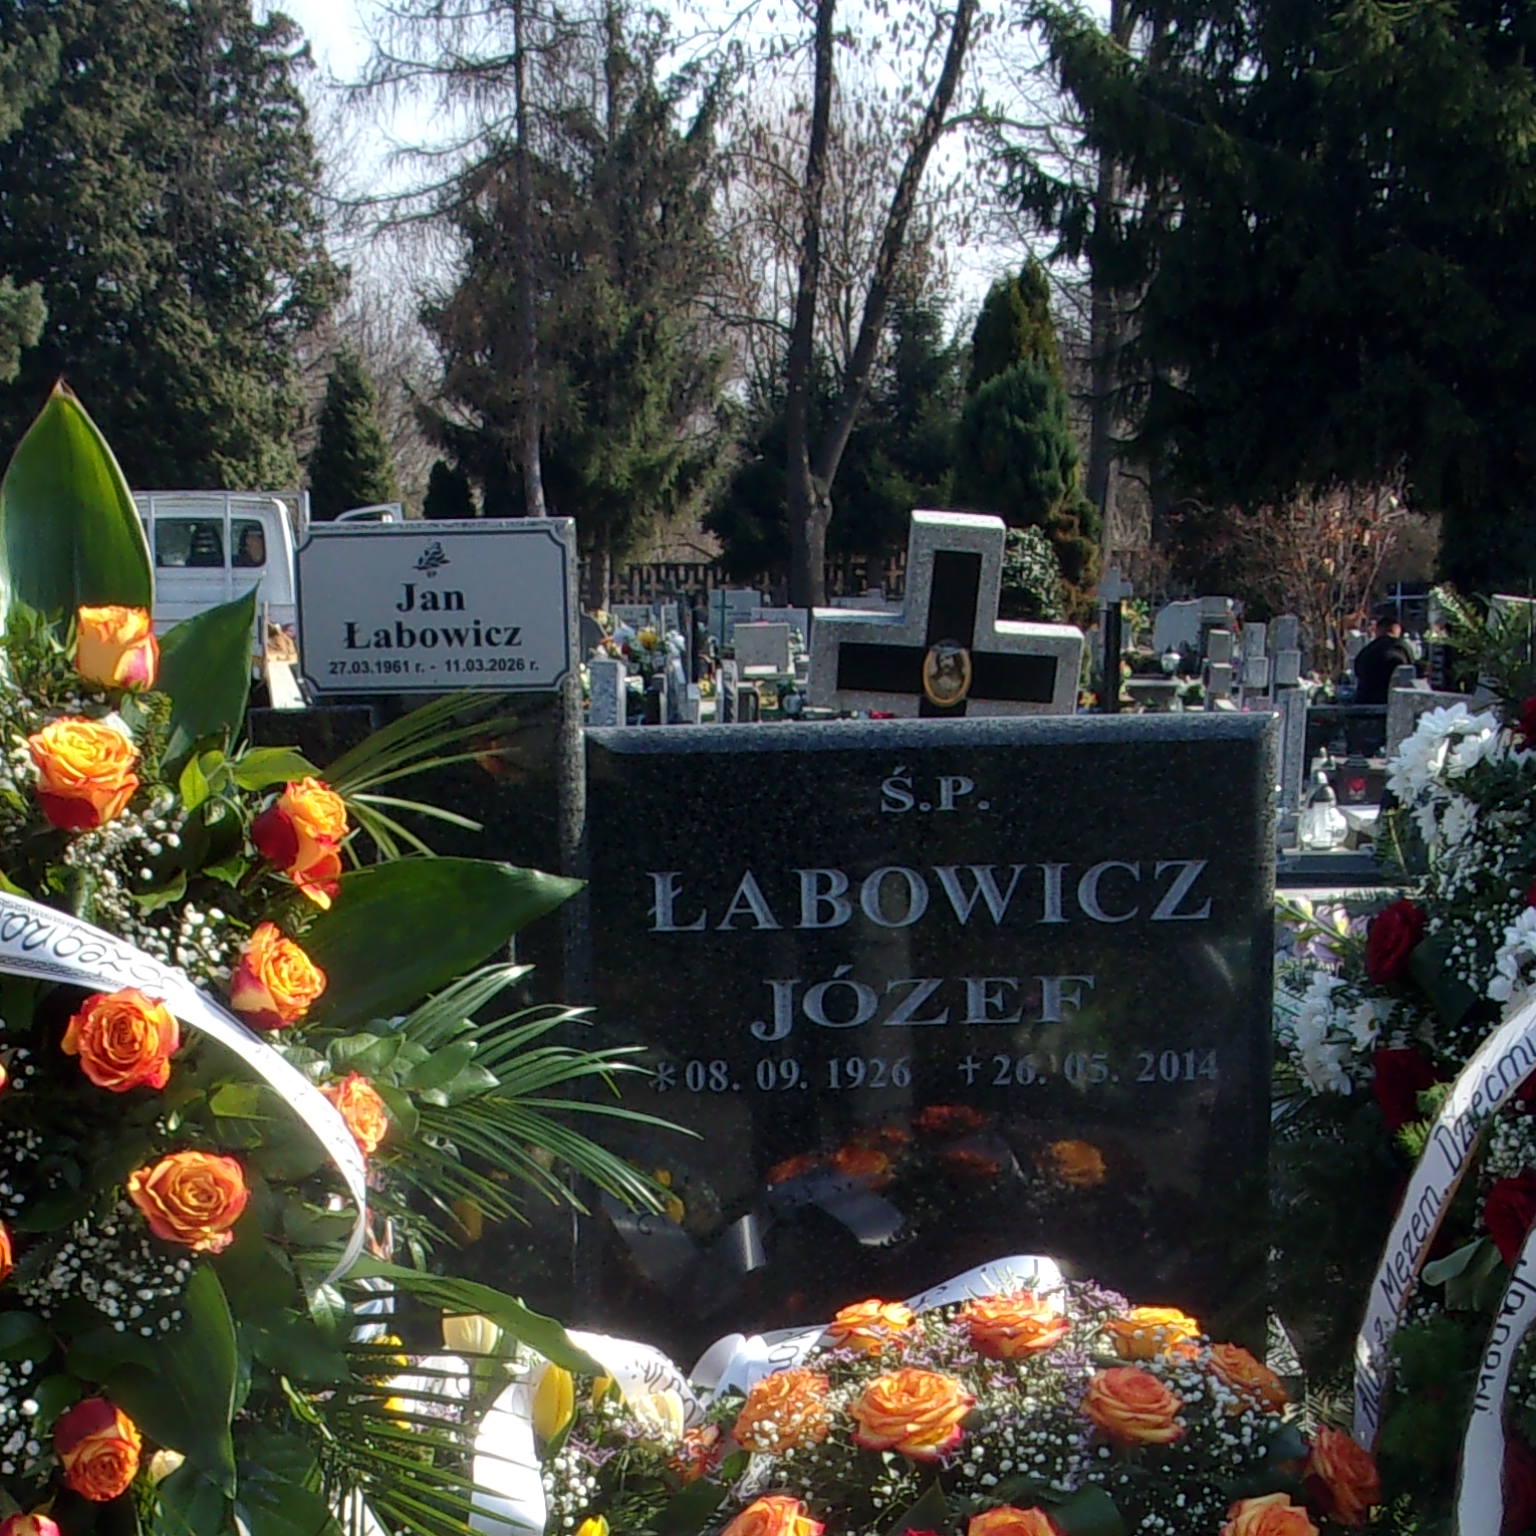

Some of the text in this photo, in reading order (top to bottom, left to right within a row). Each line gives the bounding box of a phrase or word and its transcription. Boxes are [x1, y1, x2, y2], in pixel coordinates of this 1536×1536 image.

[395, 582, 466, 613] Jan
[343, 619, 522, 650] Łabowicz
[329, 660, 410, 675] 27.03.1961
[444, 657, 526, 673] 11.03.2026
[880, 765, 991, 813] Ś.P.
[644, 859, 1213, 933] ŁABOWICZ
[749, 964, 1097, 1042] JÓZEF
[827, 1055, 913, 1089] 1926
[1137, 1048, 1220, 1083] 2014
